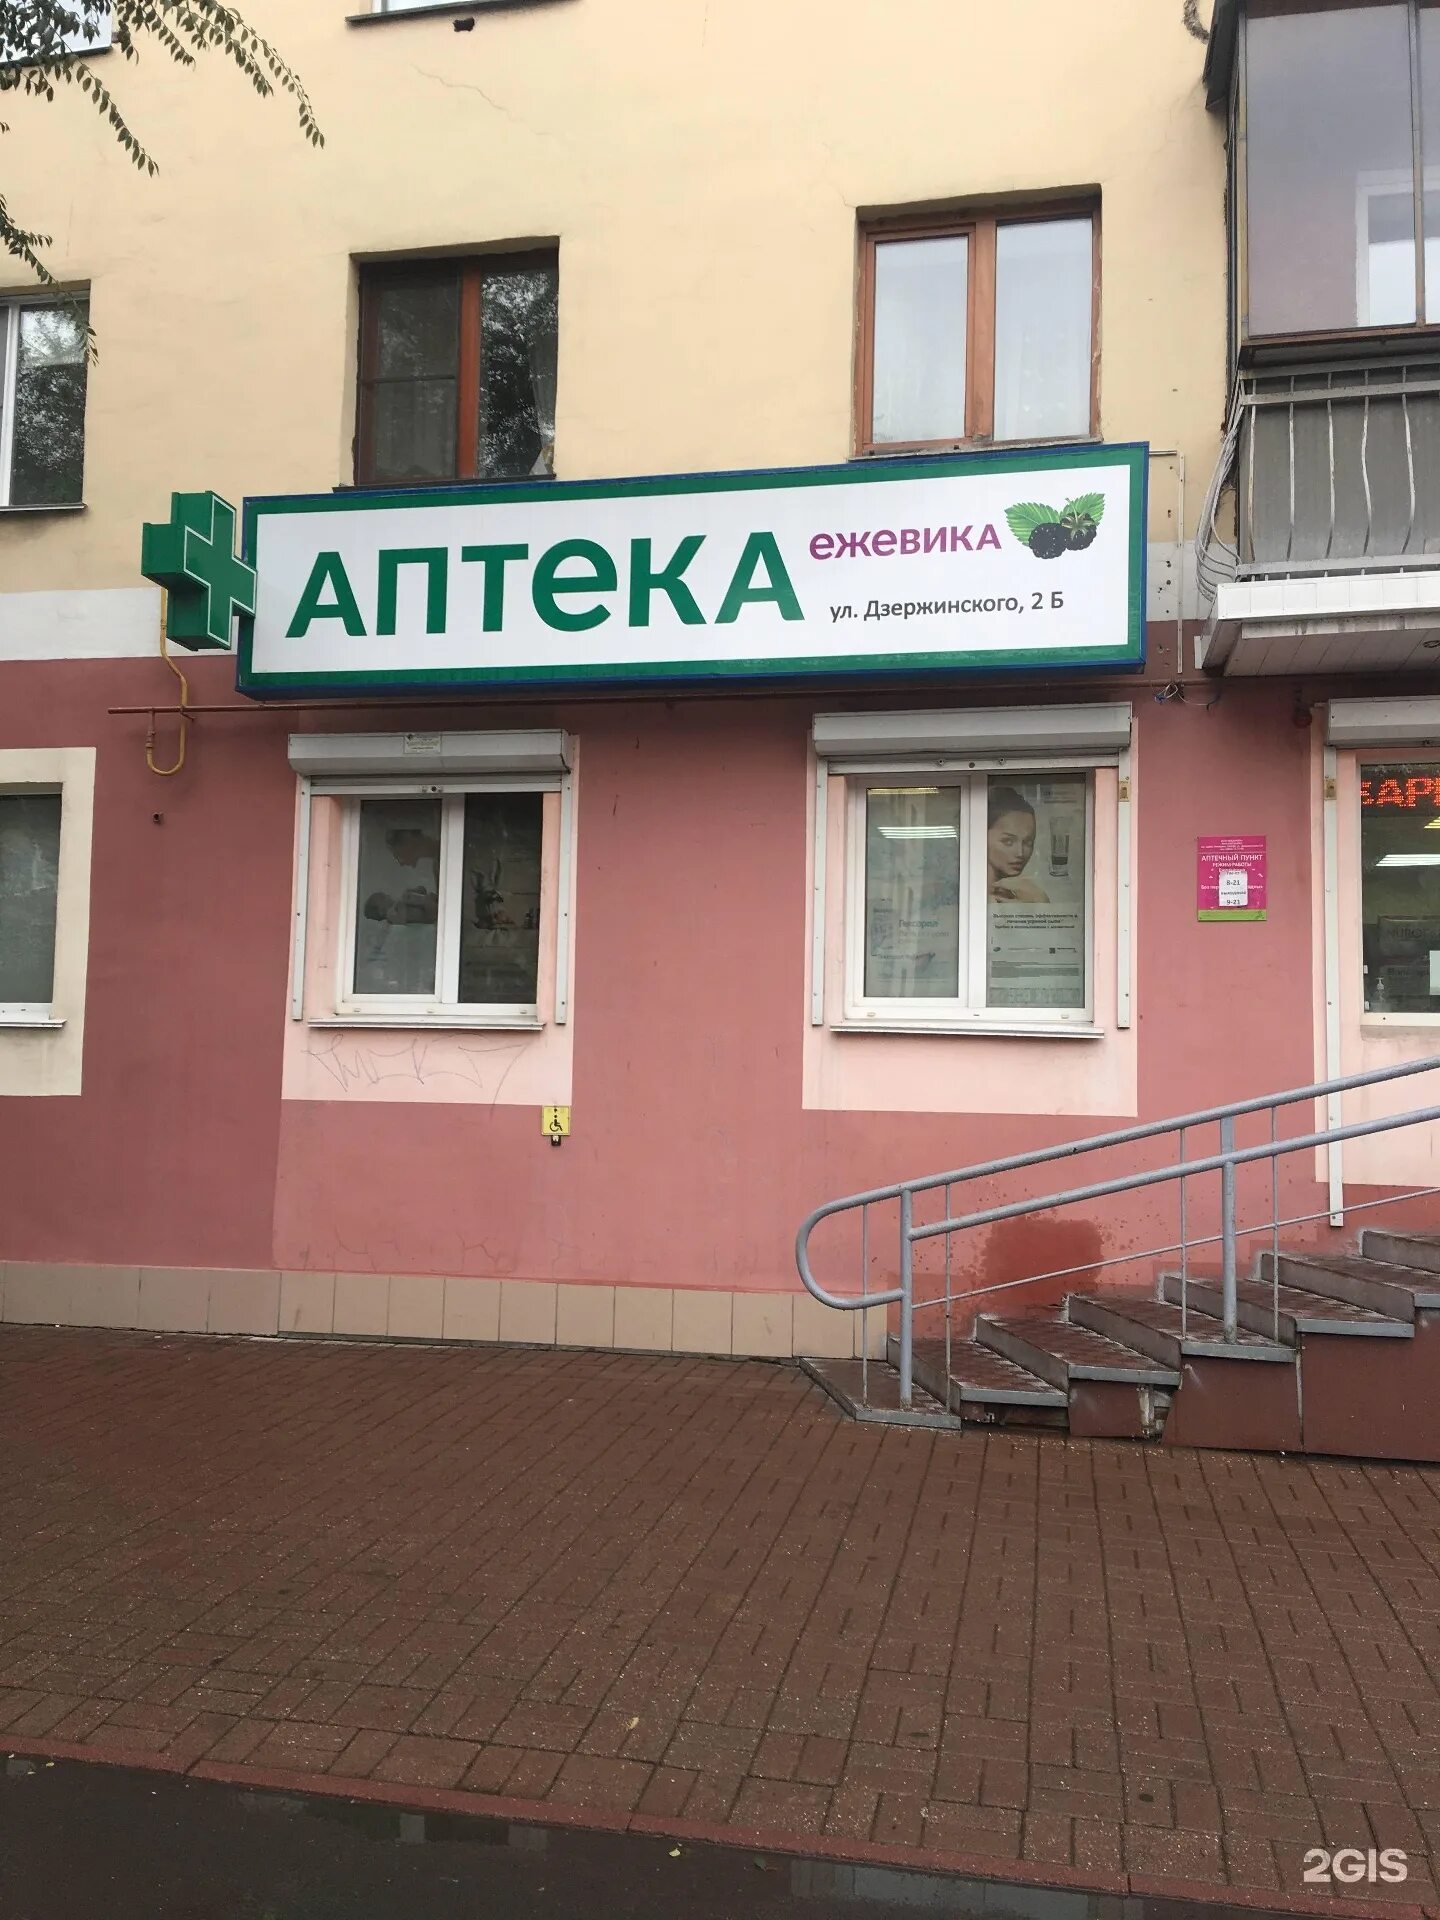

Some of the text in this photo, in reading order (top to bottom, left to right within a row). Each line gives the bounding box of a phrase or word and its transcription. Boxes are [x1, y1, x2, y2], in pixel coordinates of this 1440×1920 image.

[830, 591, 1064, 623] ул. Дзержинского, 2 Б
[1201, 853, 1239, 862] АПТЕЧНЫЙ
